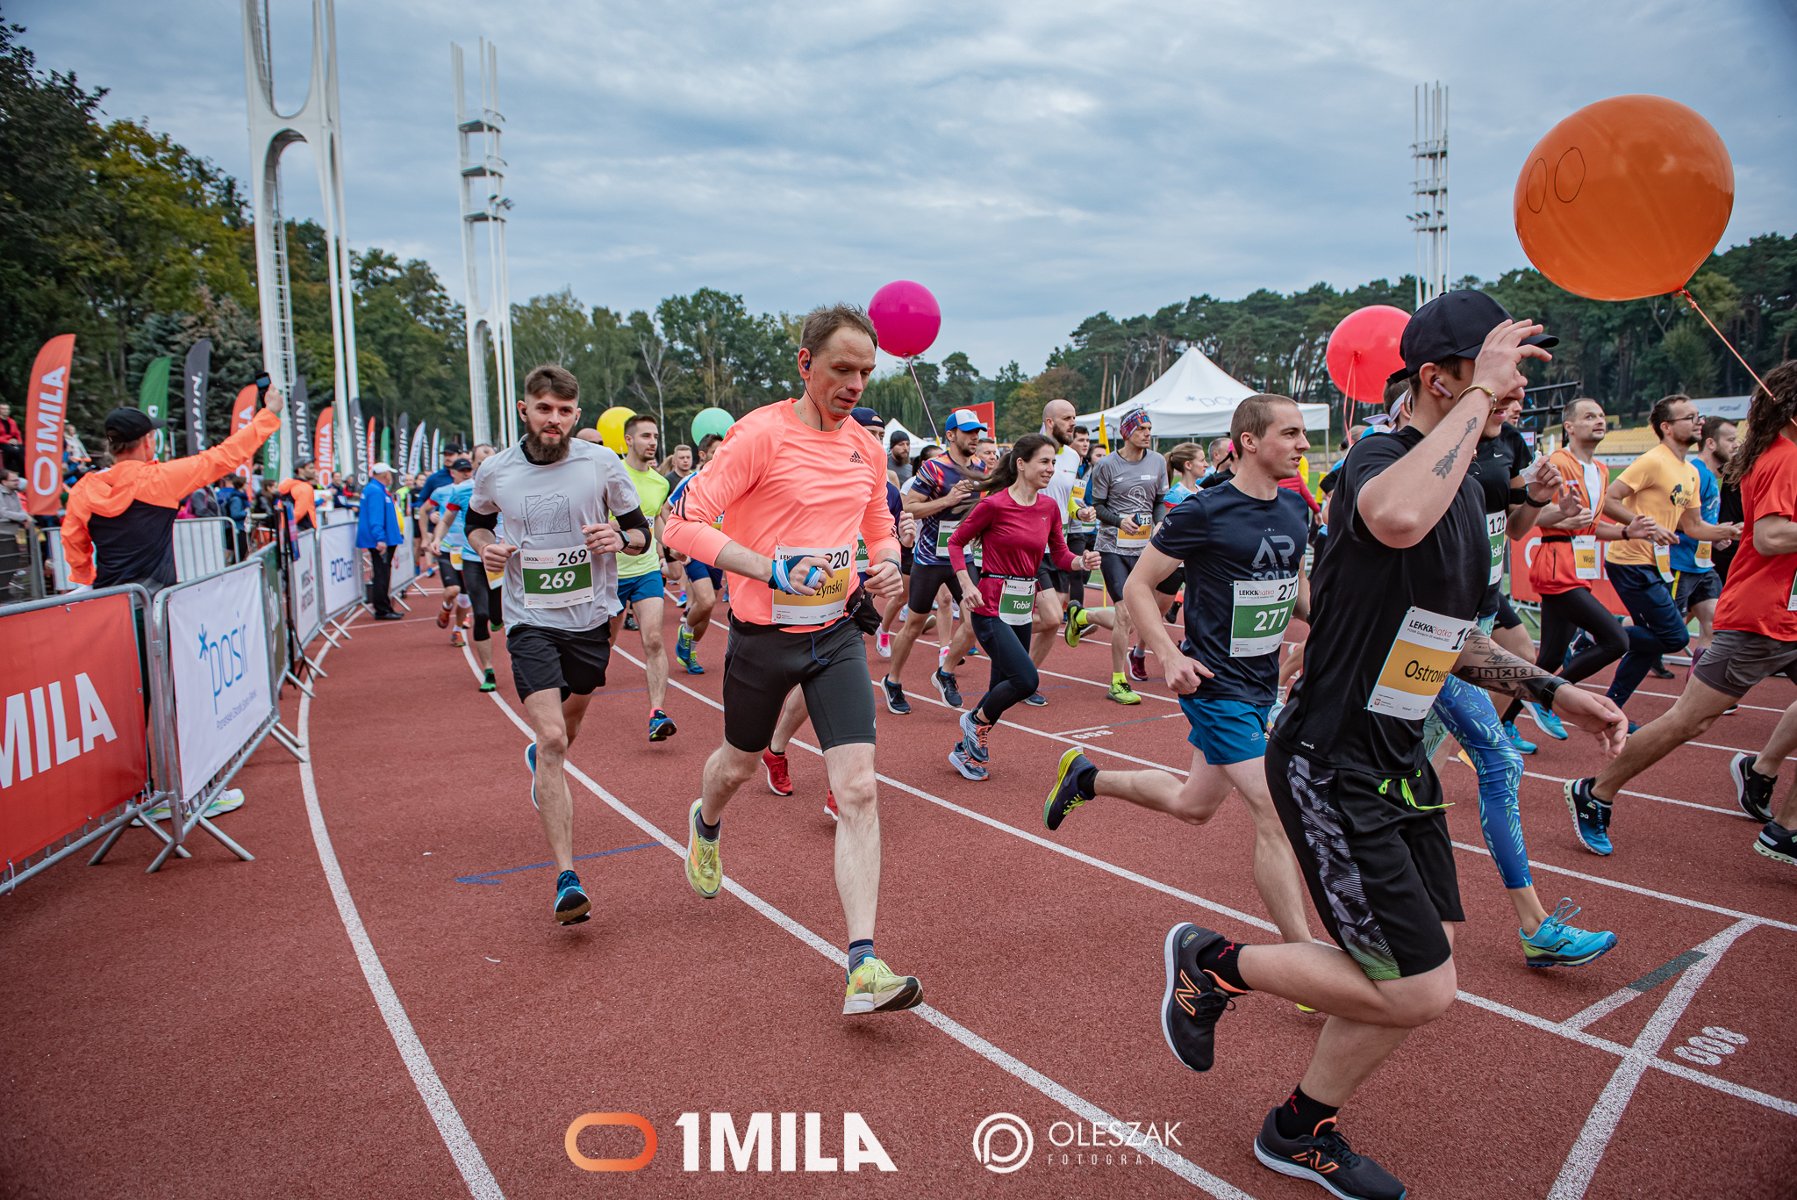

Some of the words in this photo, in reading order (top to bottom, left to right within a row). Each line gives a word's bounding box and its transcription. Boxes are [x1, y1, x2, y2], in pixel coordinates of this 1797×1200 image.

[296, 401, 311, 457] RMIN
[353, 416, 370, 486] GARMIN
[558, 549, 588, 567] 269
[539, 571, 576, 590] 269
[1253, 606, 1289, 632] 277
[208, 609, 249, 715] posir
